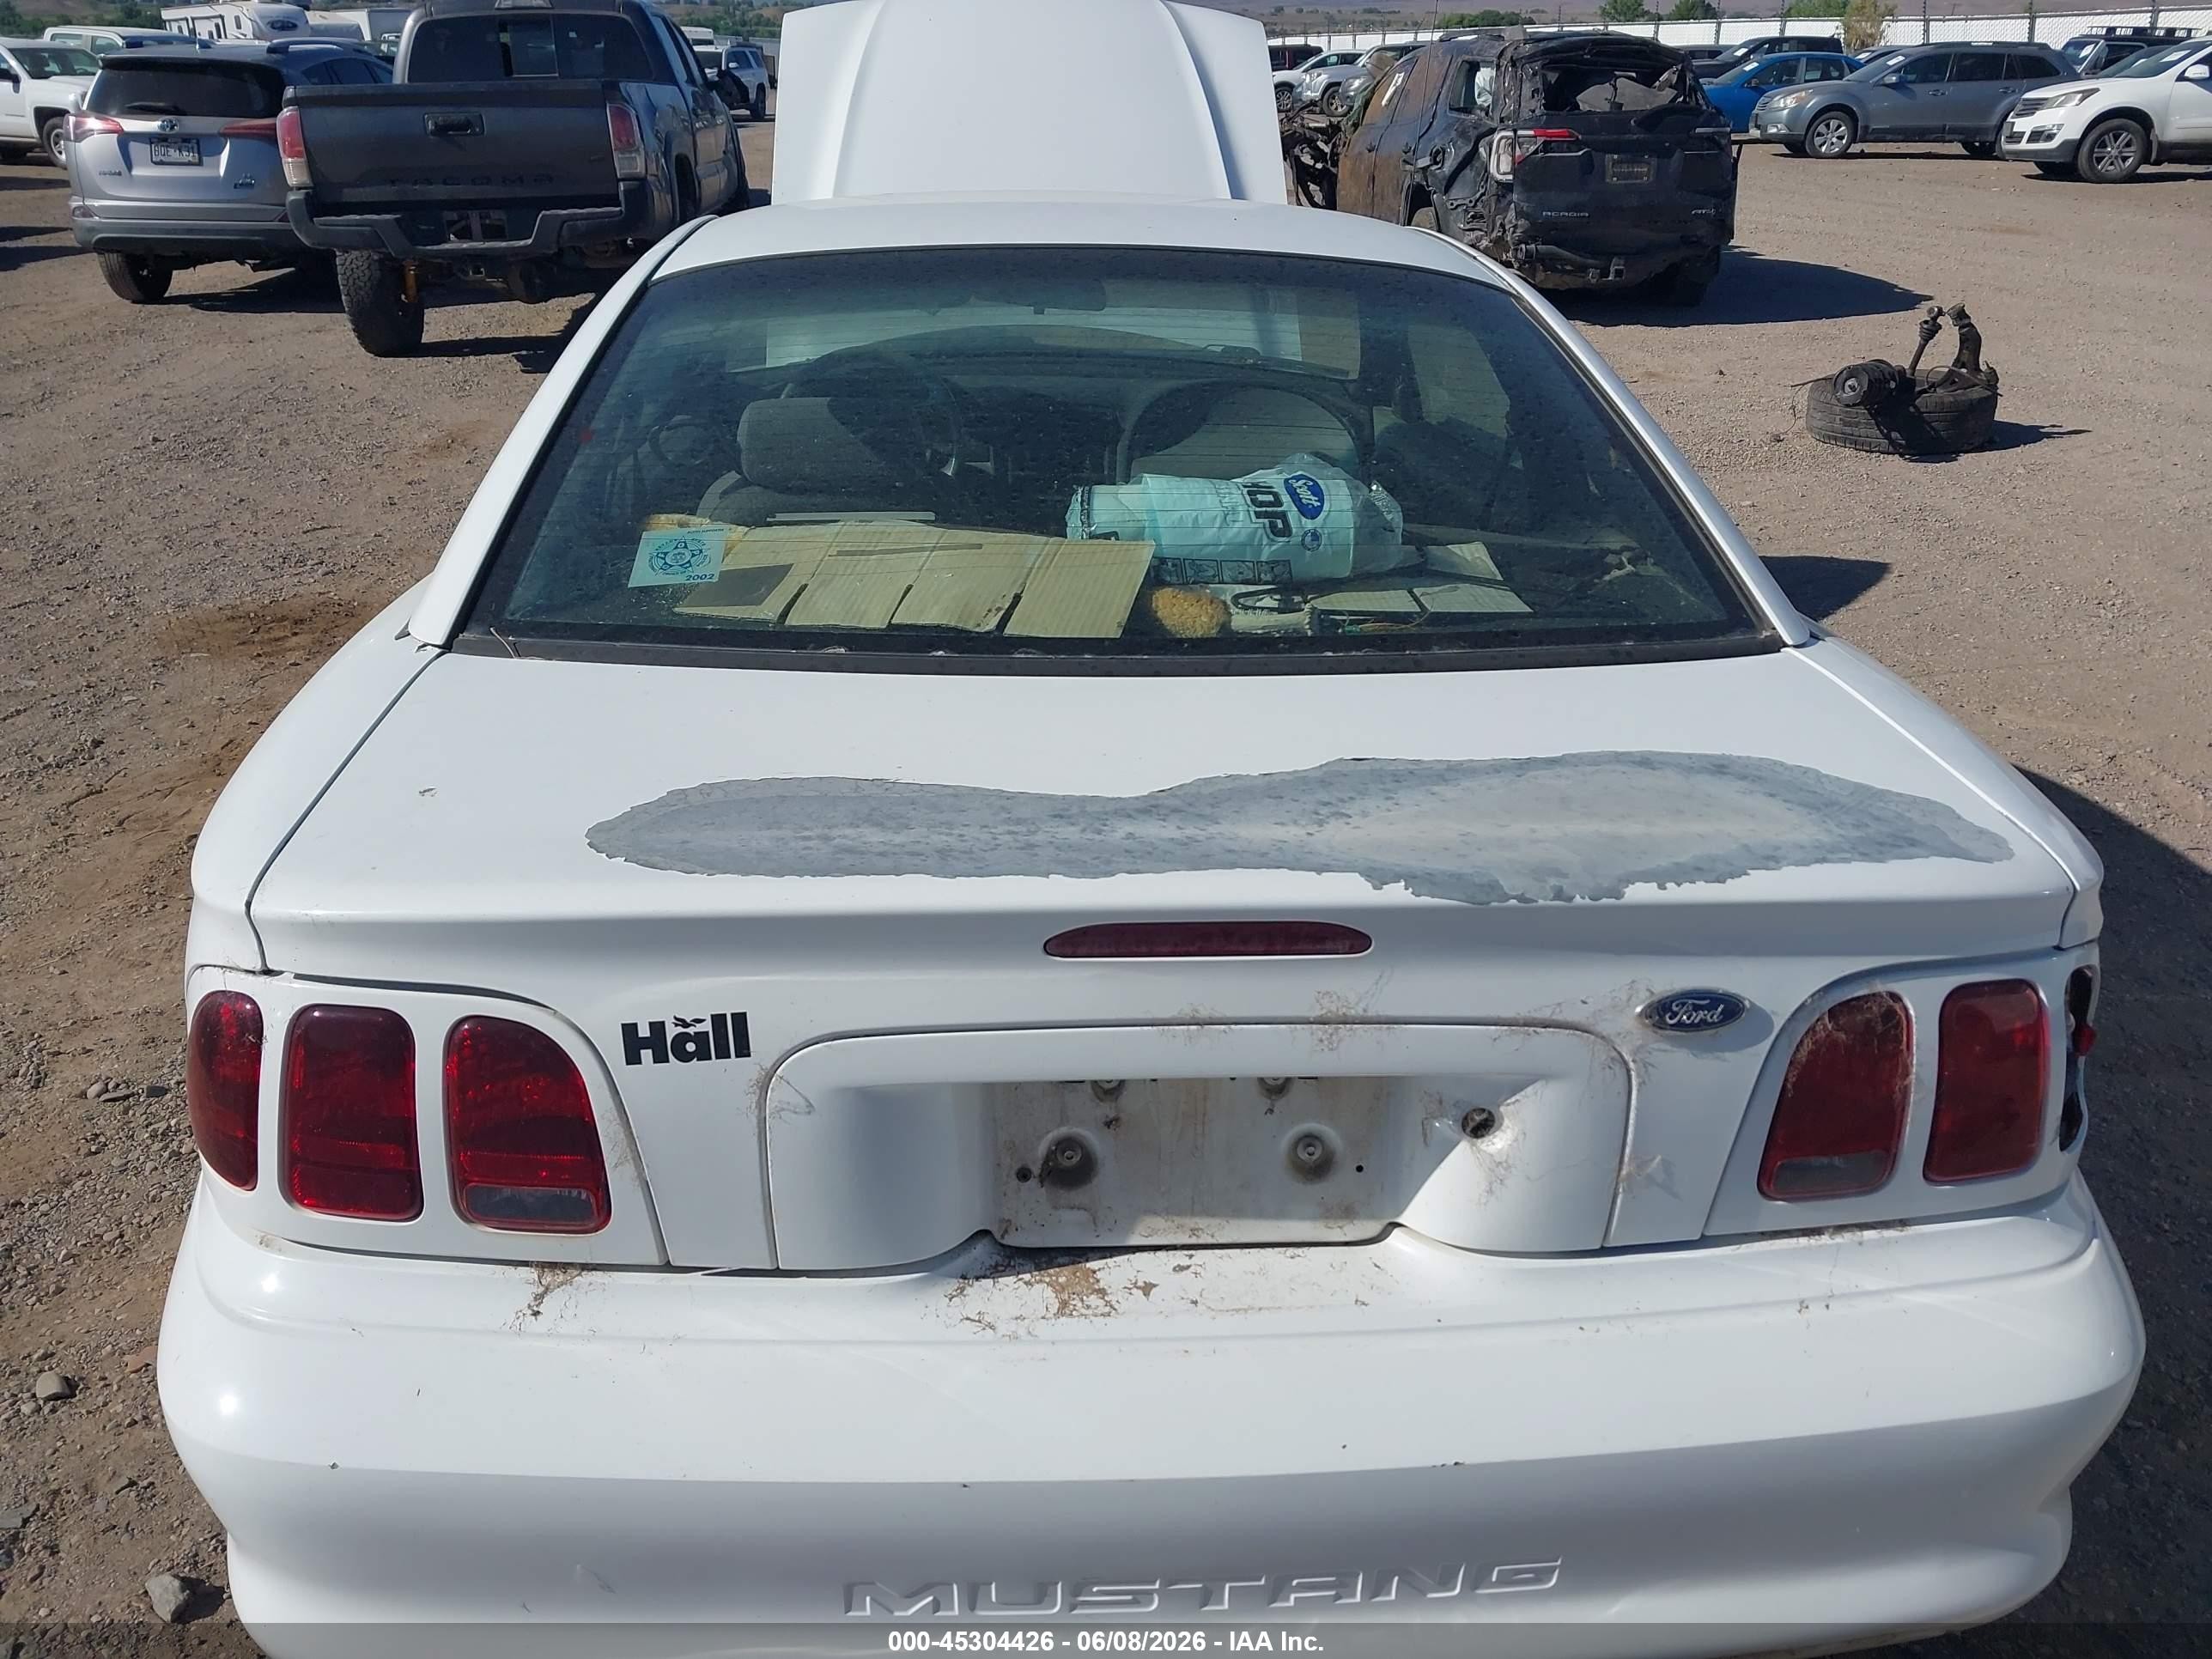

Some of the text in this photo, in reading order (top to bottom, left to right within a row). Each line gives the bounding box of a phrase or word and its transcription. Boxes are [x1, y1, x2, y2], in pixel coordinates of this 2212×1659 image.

[389, 175, 554, 188] TACOMA
[1287, 478, 1322, 509] Scott
[685, 573, 715, 581] 2002
[1665, 999, 1724, 1024] Ford
[621, 1012, 751, 1066] Hall
[843, 1556, 1562, 1616] MUSTANG
